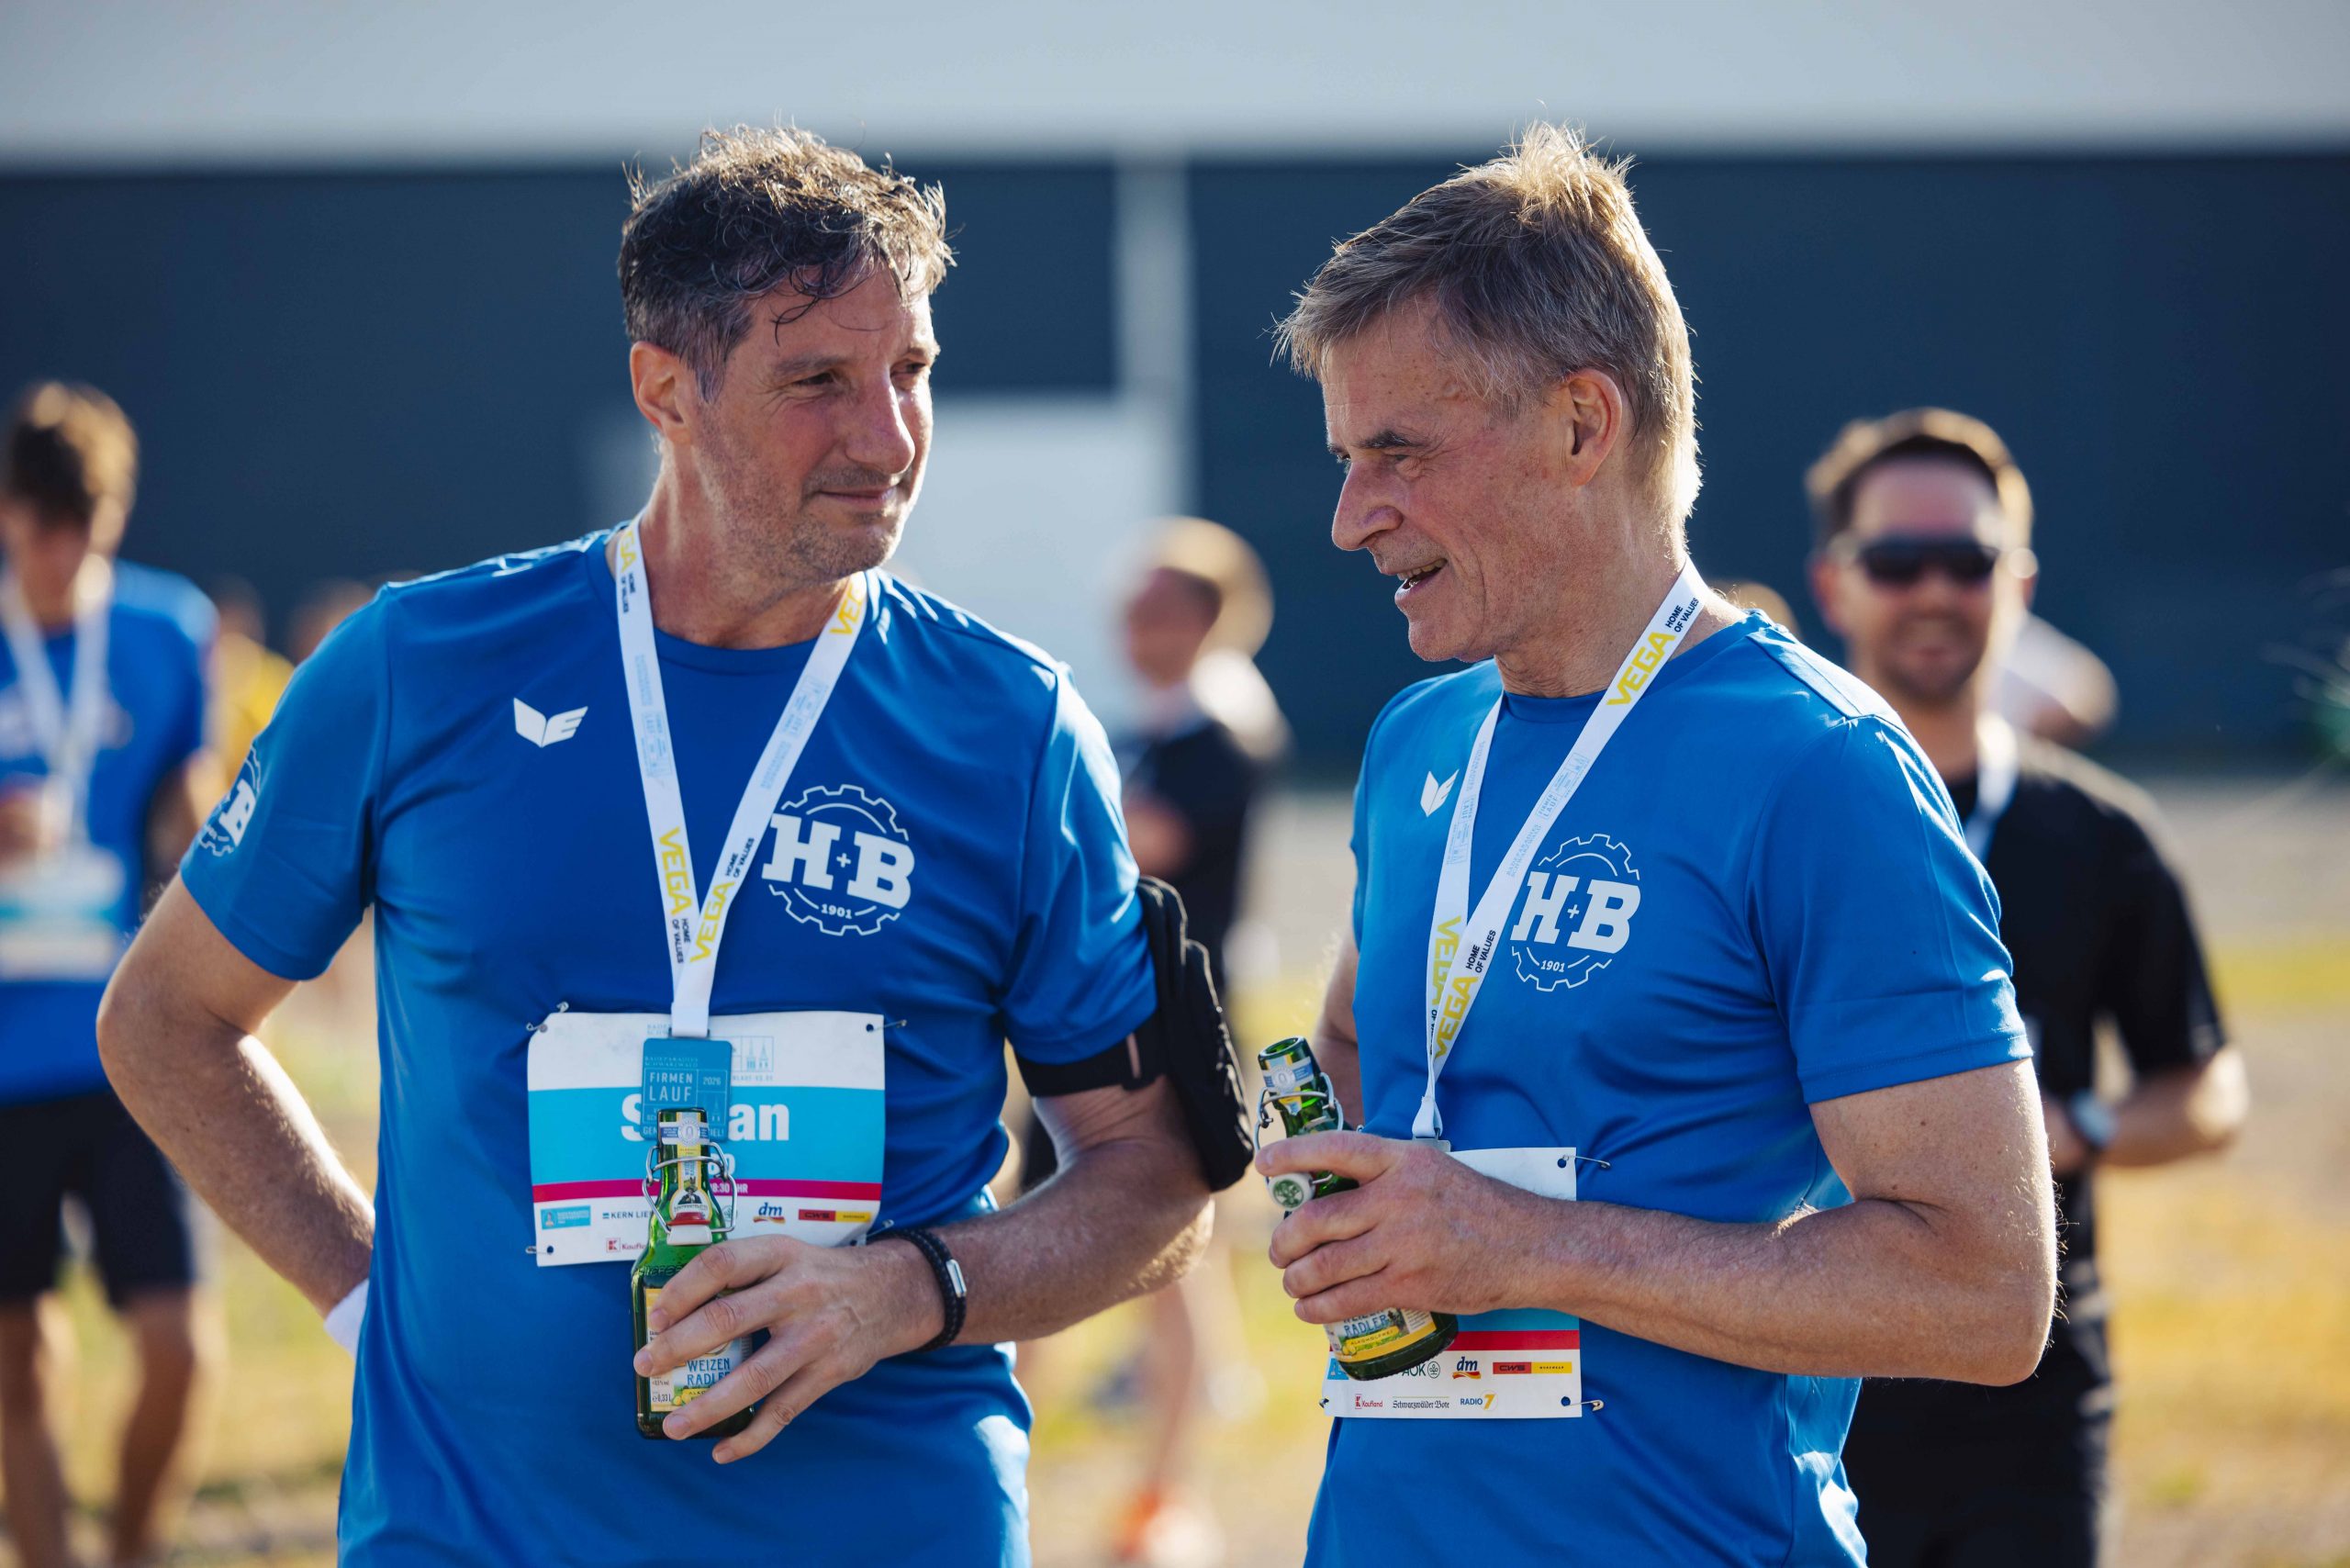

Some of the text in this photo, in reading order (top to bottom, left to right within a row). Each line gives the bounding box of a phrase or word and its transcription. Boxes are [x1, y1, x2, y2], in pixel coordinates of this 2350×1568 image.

[1664, 605, 1684, 629] HOME
[1673, 597, 1699, 633] OF VALUES
[1606, 632, 1676, 705] VEGA
[725, 853, 738, 877] HOME
[733, 837, 755, 878] OF VALUES
[761, 812, 915, 910] H+B
[659, 826, 692, 915] VEGA
[689, 881, 735, 962] VEGA
[822, 903, 852, 919] 1901
[1510, 870, 1641, 954] H+B
[672, 919, 684, 964] OF VALUES
[682, 918, 691, 944] HOME
[1465, 944, 1480, 969] HOME
[1474, 929, 1496, 973] OF VALUES
[1540, 959, 1565, 973] 1901
[1434, 975, 1479, 1058] VEGA
[649, 1071, 693, 1084] FIRMEN
[649, 1086, 692, 1102] LAUF
[611, 1211, 633, 1220] KERN
[758, 1202, 782, 1216] dm
[1343, 1314, 1388, 1338] RADLER
[687, 1358, 731, 1372] WEIZEN
[1456, 1357, 1478, 1372] dm
[1361, 1399, 1383, 1407] Kaufland
[1393, 1400, 1449, 1409] Schwarzwälder Bote
[1460, 1394, 1496, 1410] RADIO 7
